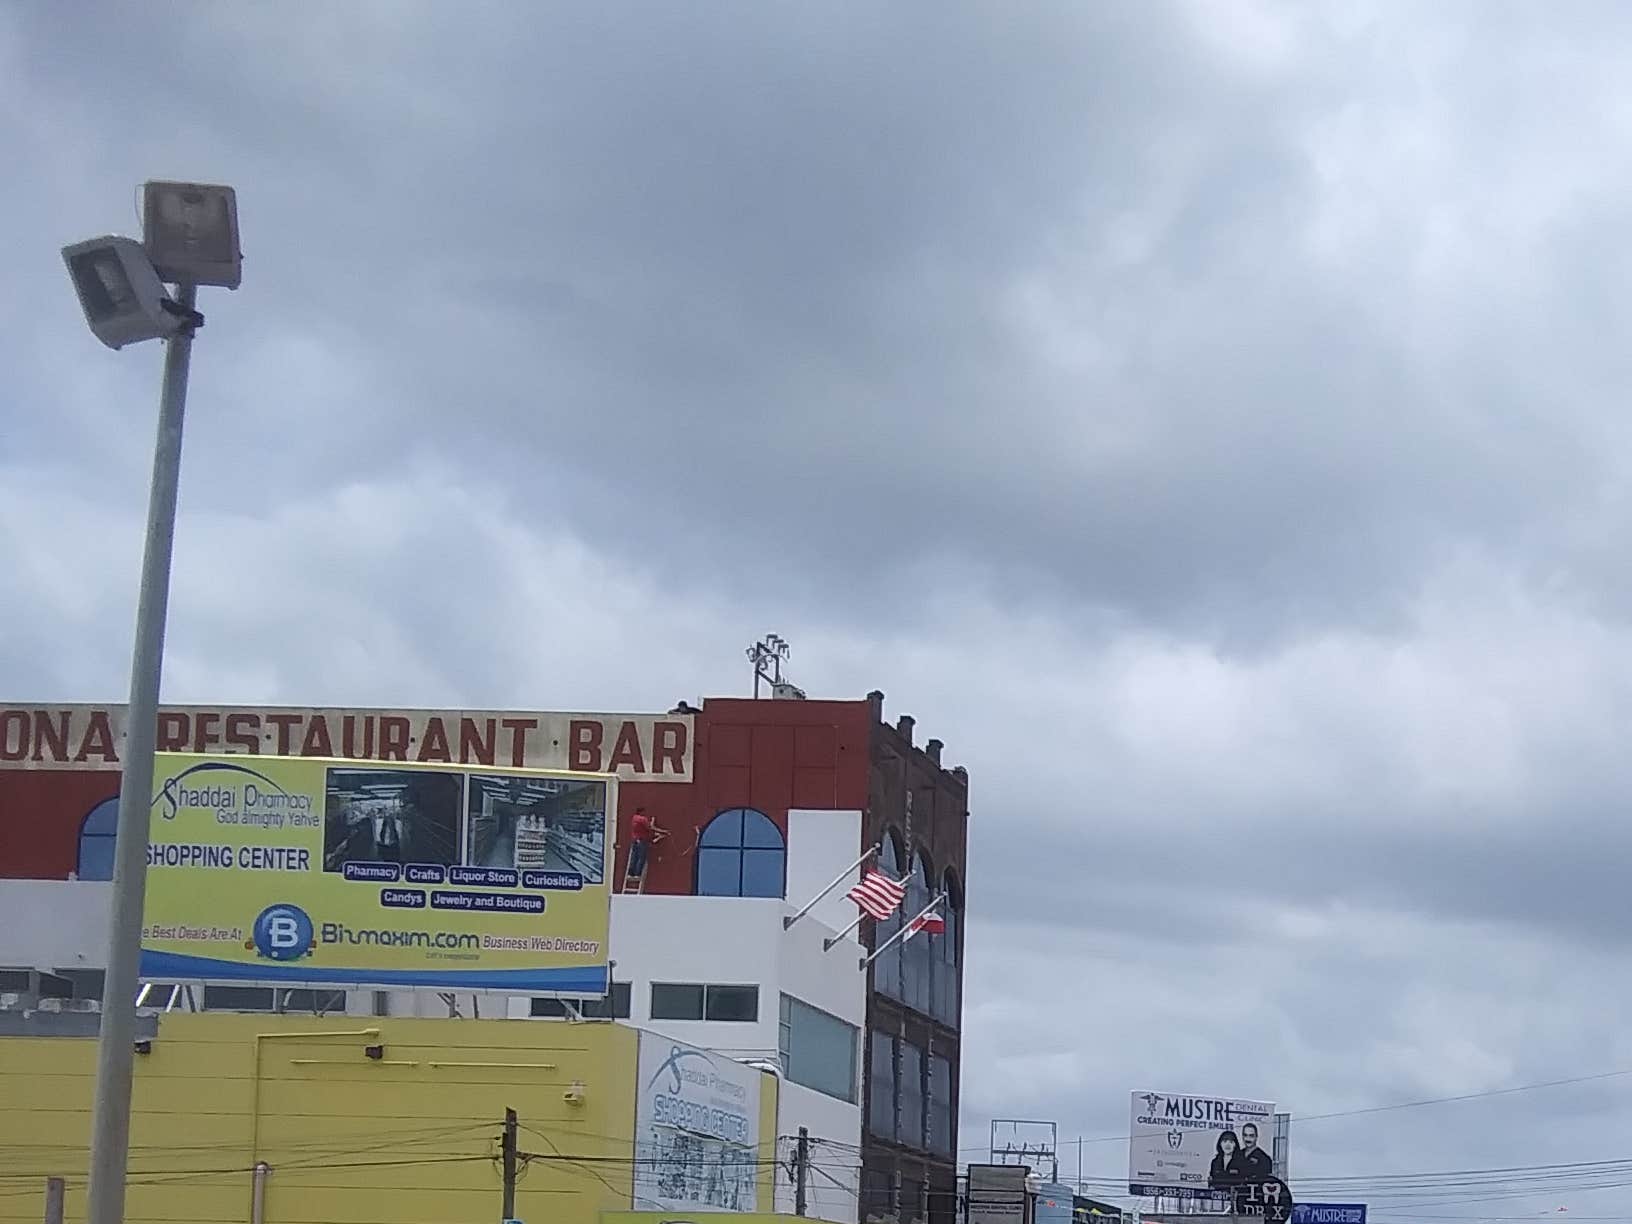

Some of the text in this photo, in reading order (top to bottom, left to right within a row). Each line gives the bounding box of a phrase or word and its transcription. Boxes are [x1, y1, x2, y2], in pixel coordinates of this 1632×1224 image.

[0, 710, 687, 774] ONA RESTAURANT BAR
[163, 778, 313, 820] Shaddai Pharmacy
[216, 808, 238, 824] God
[147, 844, 310, 870] SHOPPING CENTER
[346, 866, 580, 887] Pharmacy Crafts Liquor Store Curiosities
[384, 892, 542, 911] Candys Jewelry and Boutique
[152, 926, 176, 939] Best
[178, 927, 207, 940] Deals
[210, 928, 228, 940] Are
[321, 923, 479, 949] Bizmaxim.com
[483, 936, 600, 954] Business Web Directory
[1165, 1098, 1234, 1122] MUSTRE
[1137, 1116, 1174, 1126] CREATING
[1176, 1118, 1207, 1128] PERFECT
[1312, 1209, 1346, 1223] MUSTRE
